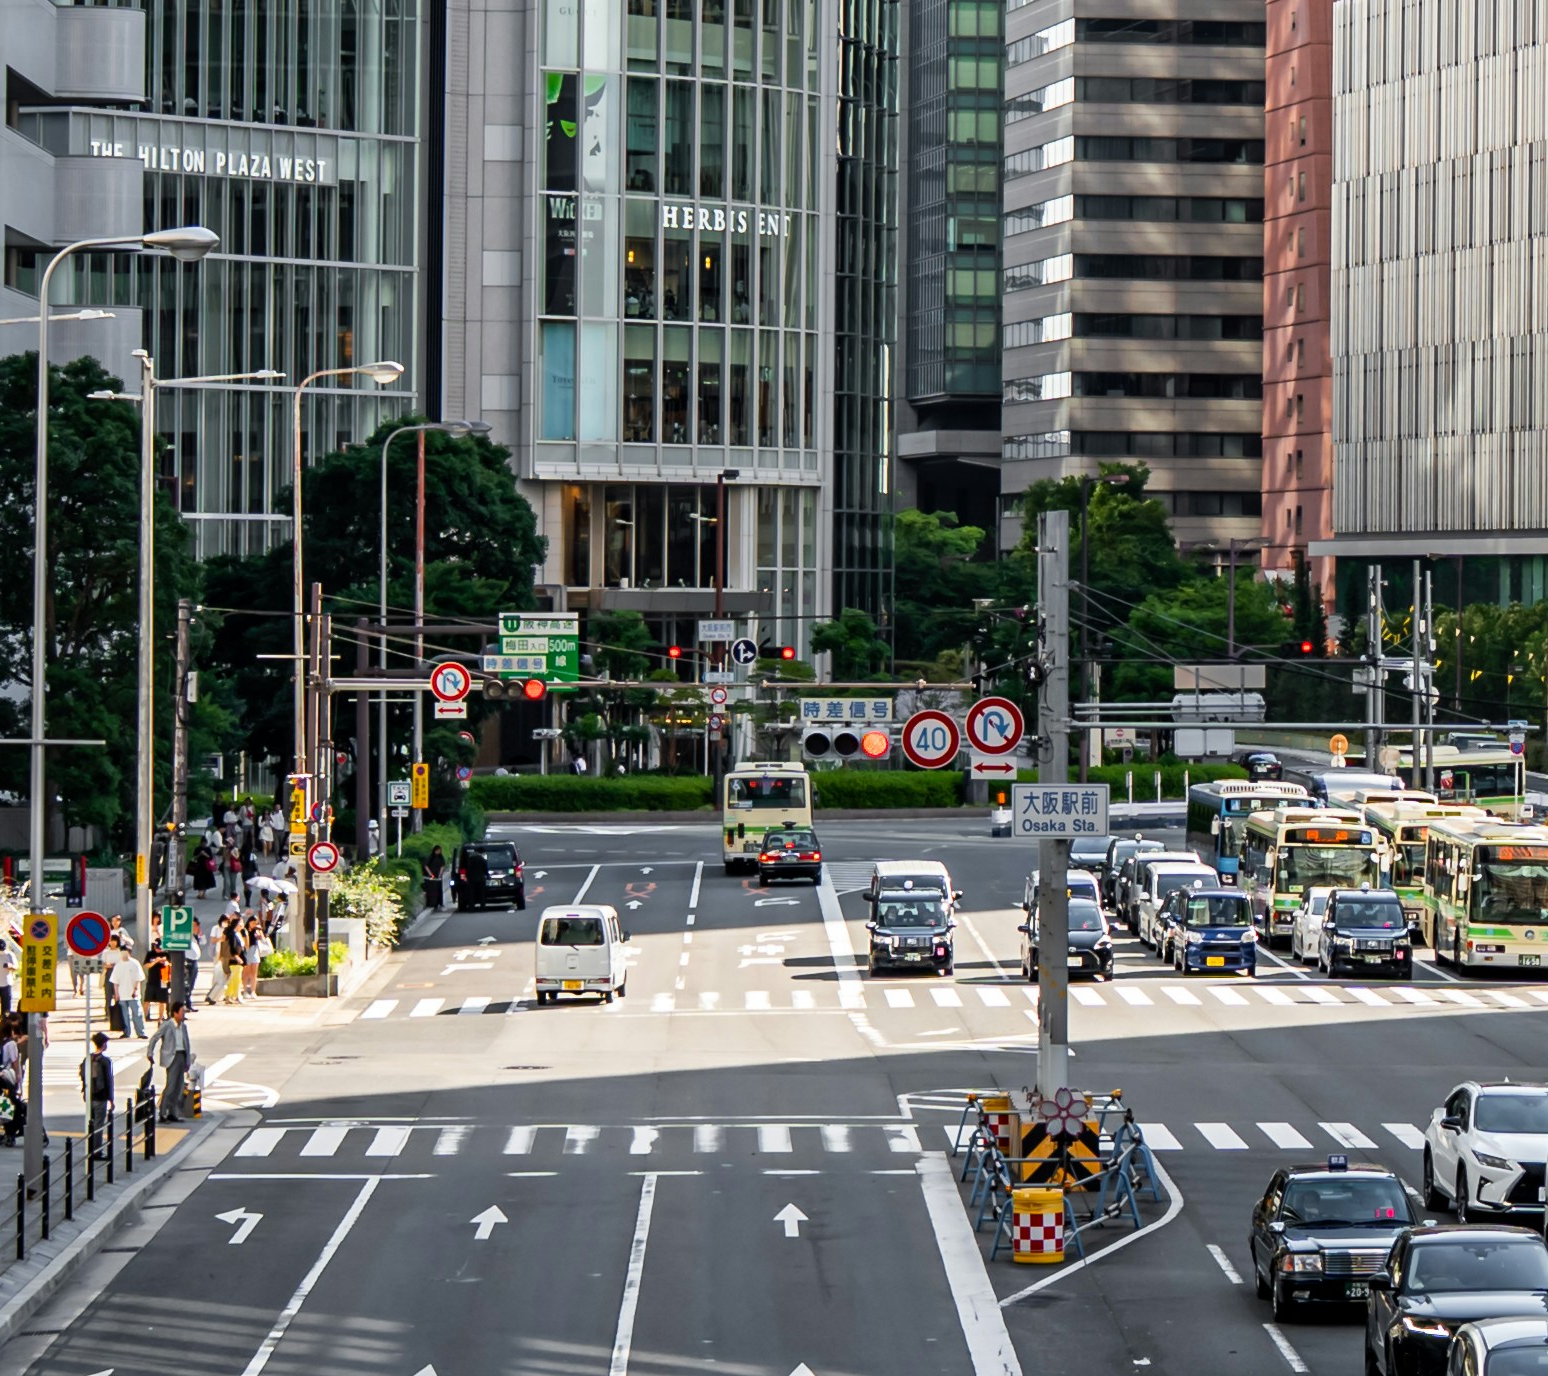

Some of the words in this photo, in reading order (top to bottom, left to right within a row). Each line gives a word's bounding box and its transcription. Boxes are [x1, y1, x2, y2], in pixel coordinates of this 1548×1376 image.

[91, 141, 123, 156] THE
[138, 145, 205, 173] HILTON
[216, 151, 272, 178] PLAZA
[279, 157, 327, 183] WEST
[662, 205, 748, 234] HERBIS
[549, 639, 576, 653] 500m
[803, 701, 889, 719] 時差信号
[916, 726, 947, 751] 40
[1022, 791, 1099, 816] 大阪駅前
[1022, 819, 1066, 833] Osaka
[1072, 818, 1100, 833] Sta.
[170, 908, 188, 932] P
[25, 945, 37, 999] 駐停車禁止
[40, 945, 52, 999] 交差点内
